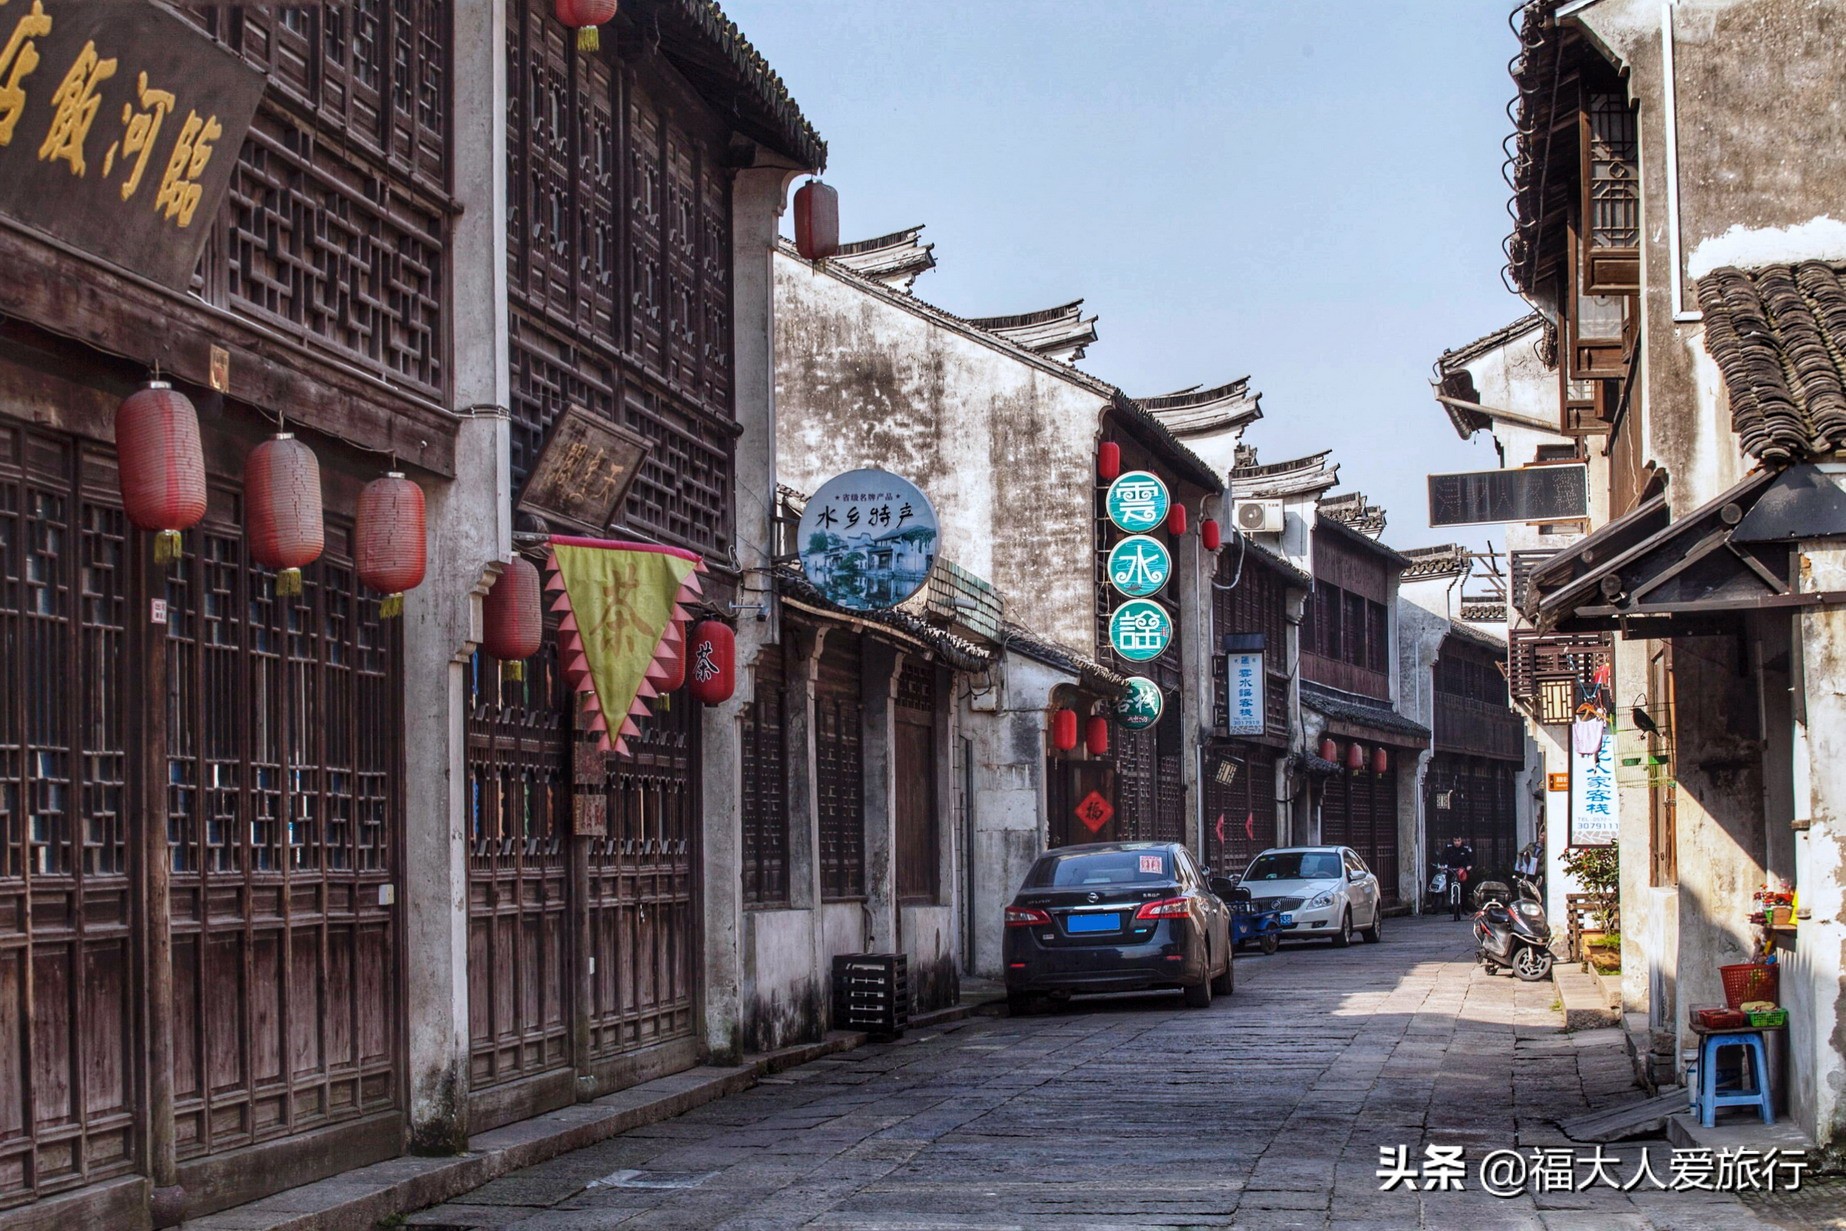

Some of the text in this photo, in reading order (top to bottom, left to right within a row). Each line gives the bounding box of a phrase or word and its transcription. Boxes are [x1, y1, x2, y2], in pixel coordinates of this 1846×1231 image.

[842, 492, 894, 502] 省级名牌产品
[815, 502, 914, 529] 水乡特产
[589, 562, 655, 657] 茶
[692, 640, 720, 681] 茶
[1086, 801, 1104, 821] 福
